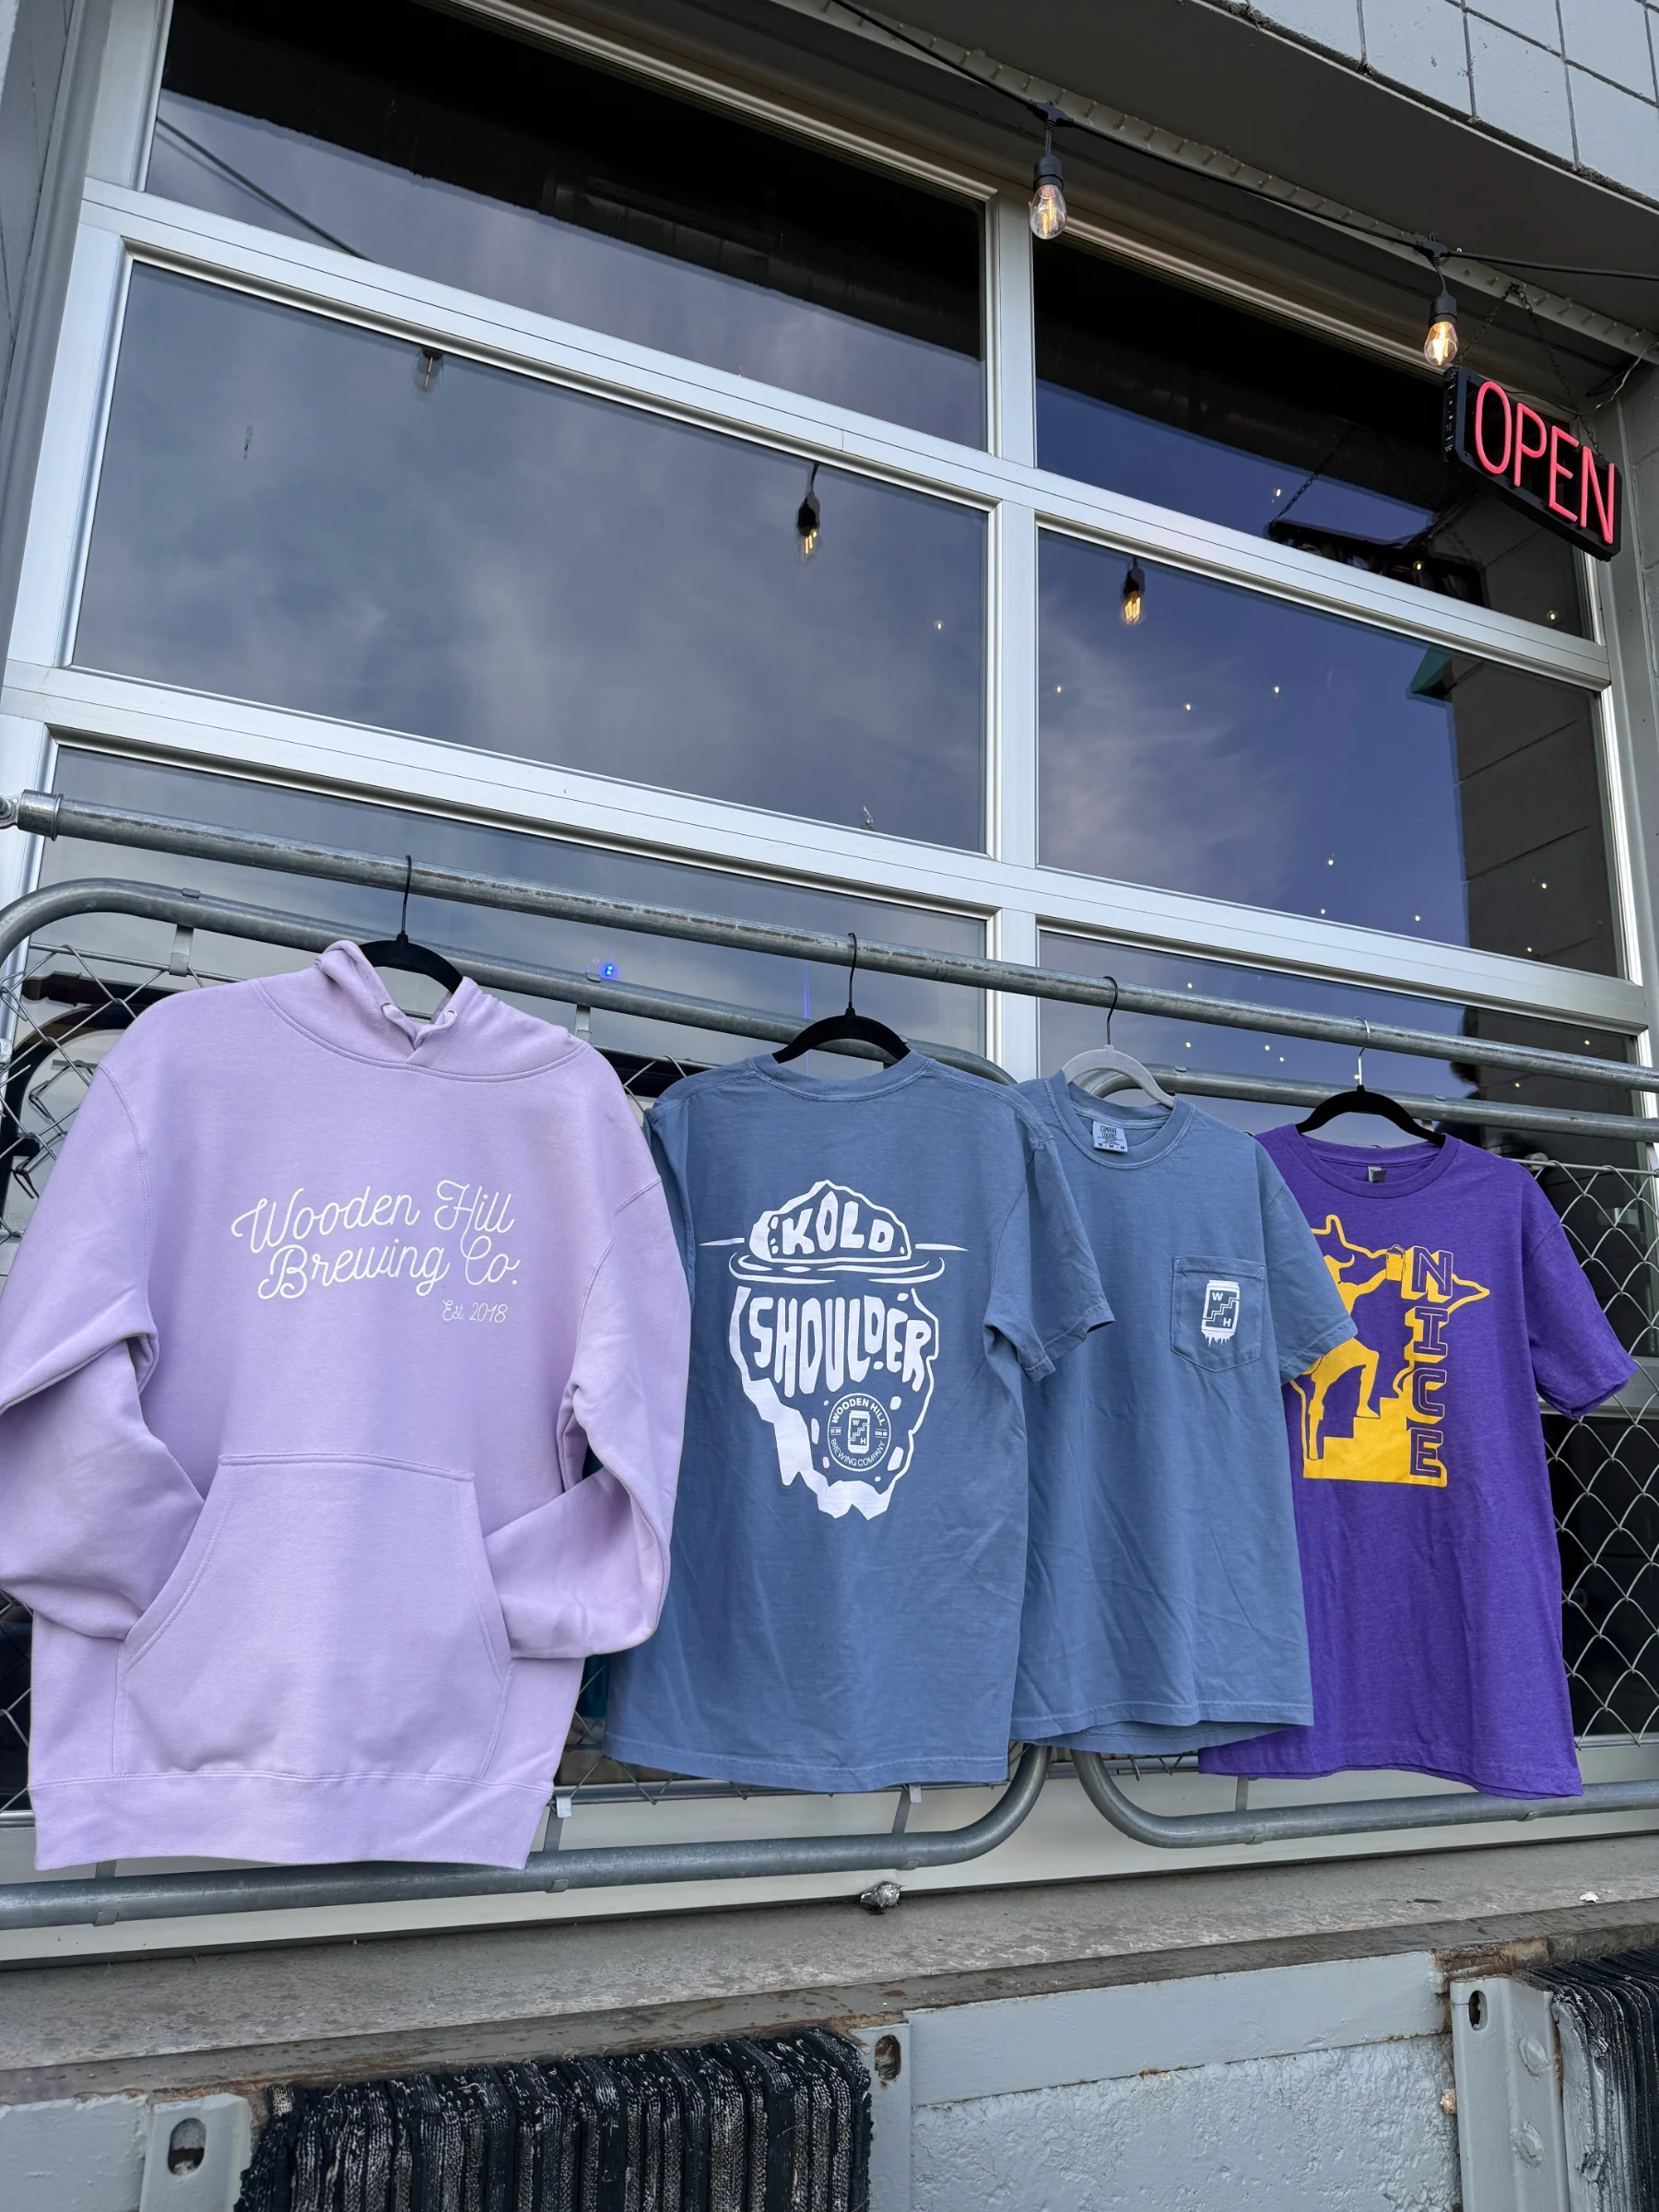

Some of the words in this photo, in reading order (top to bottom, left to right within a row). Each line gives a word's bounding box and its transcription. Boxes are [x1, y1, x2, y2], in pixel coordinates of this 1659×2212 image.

[1475, 381, 1615, 545] OPEN
[230, 1185, 420, 1253] Wooden
[433, 1179, 515, 1250] Hill
[782, 1191, 895, 1255] KOLD
[257, 1240, 451, 1300] Brewing
[460, 1234, 522, 1286] Co.
[1211, 1292, 1224, 1301] W
[468, 1301, 509, 1324] 2018
[1222, 1317, 1232, 1327] H
[748, 1295, 932, 1398] SHOULDER
[1401, 1245, 1454, 1488] NICE
[831, 1397, 870, 1424] WOODEN
[869, 1402, 886, 1427] HILL
[830, 1438, 857, 1466] BREWING
[857, 1441, 885, 1467] COMPANY
